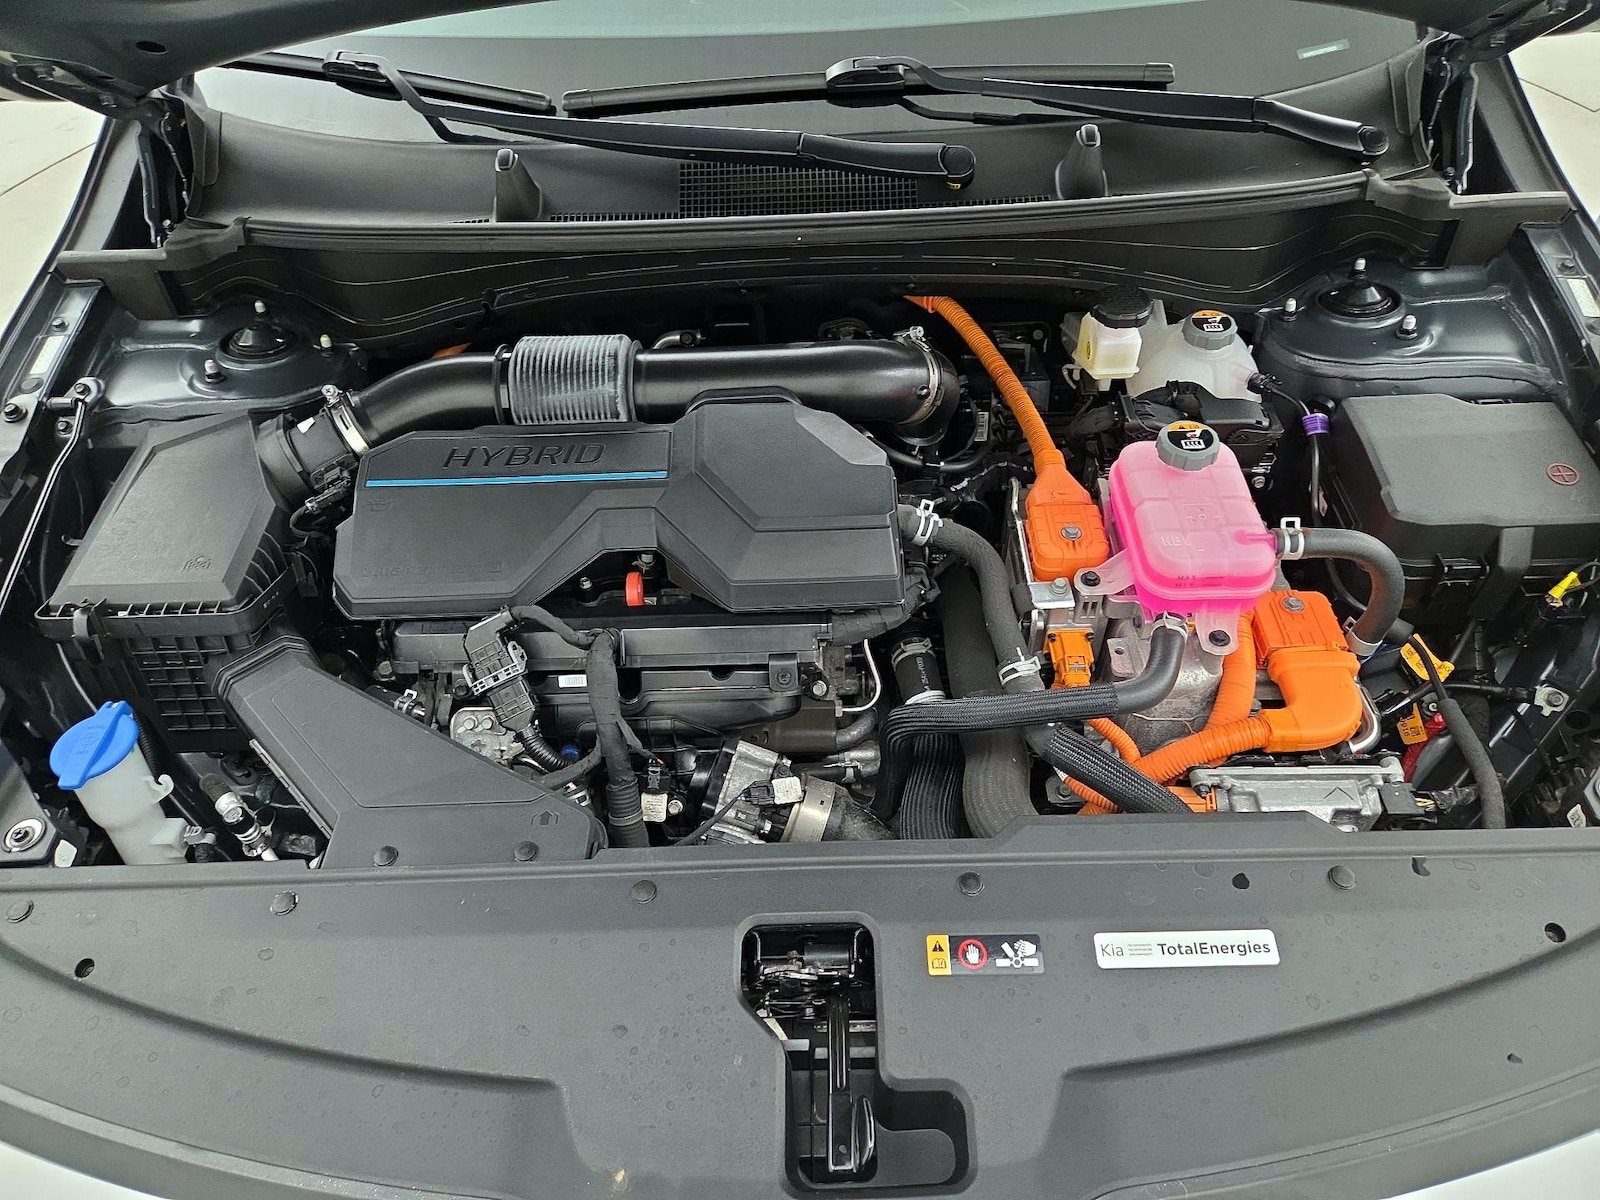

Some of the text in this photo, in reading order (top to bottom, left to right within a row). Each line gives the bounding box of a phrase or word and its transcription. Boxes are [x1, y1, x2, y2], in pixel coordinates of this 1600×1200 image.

[443, 443, 606, 469] HYBRID
[1101, 943, 1124, 957] Kia
[1157, 941, 1271, 957] TotalEnergies
